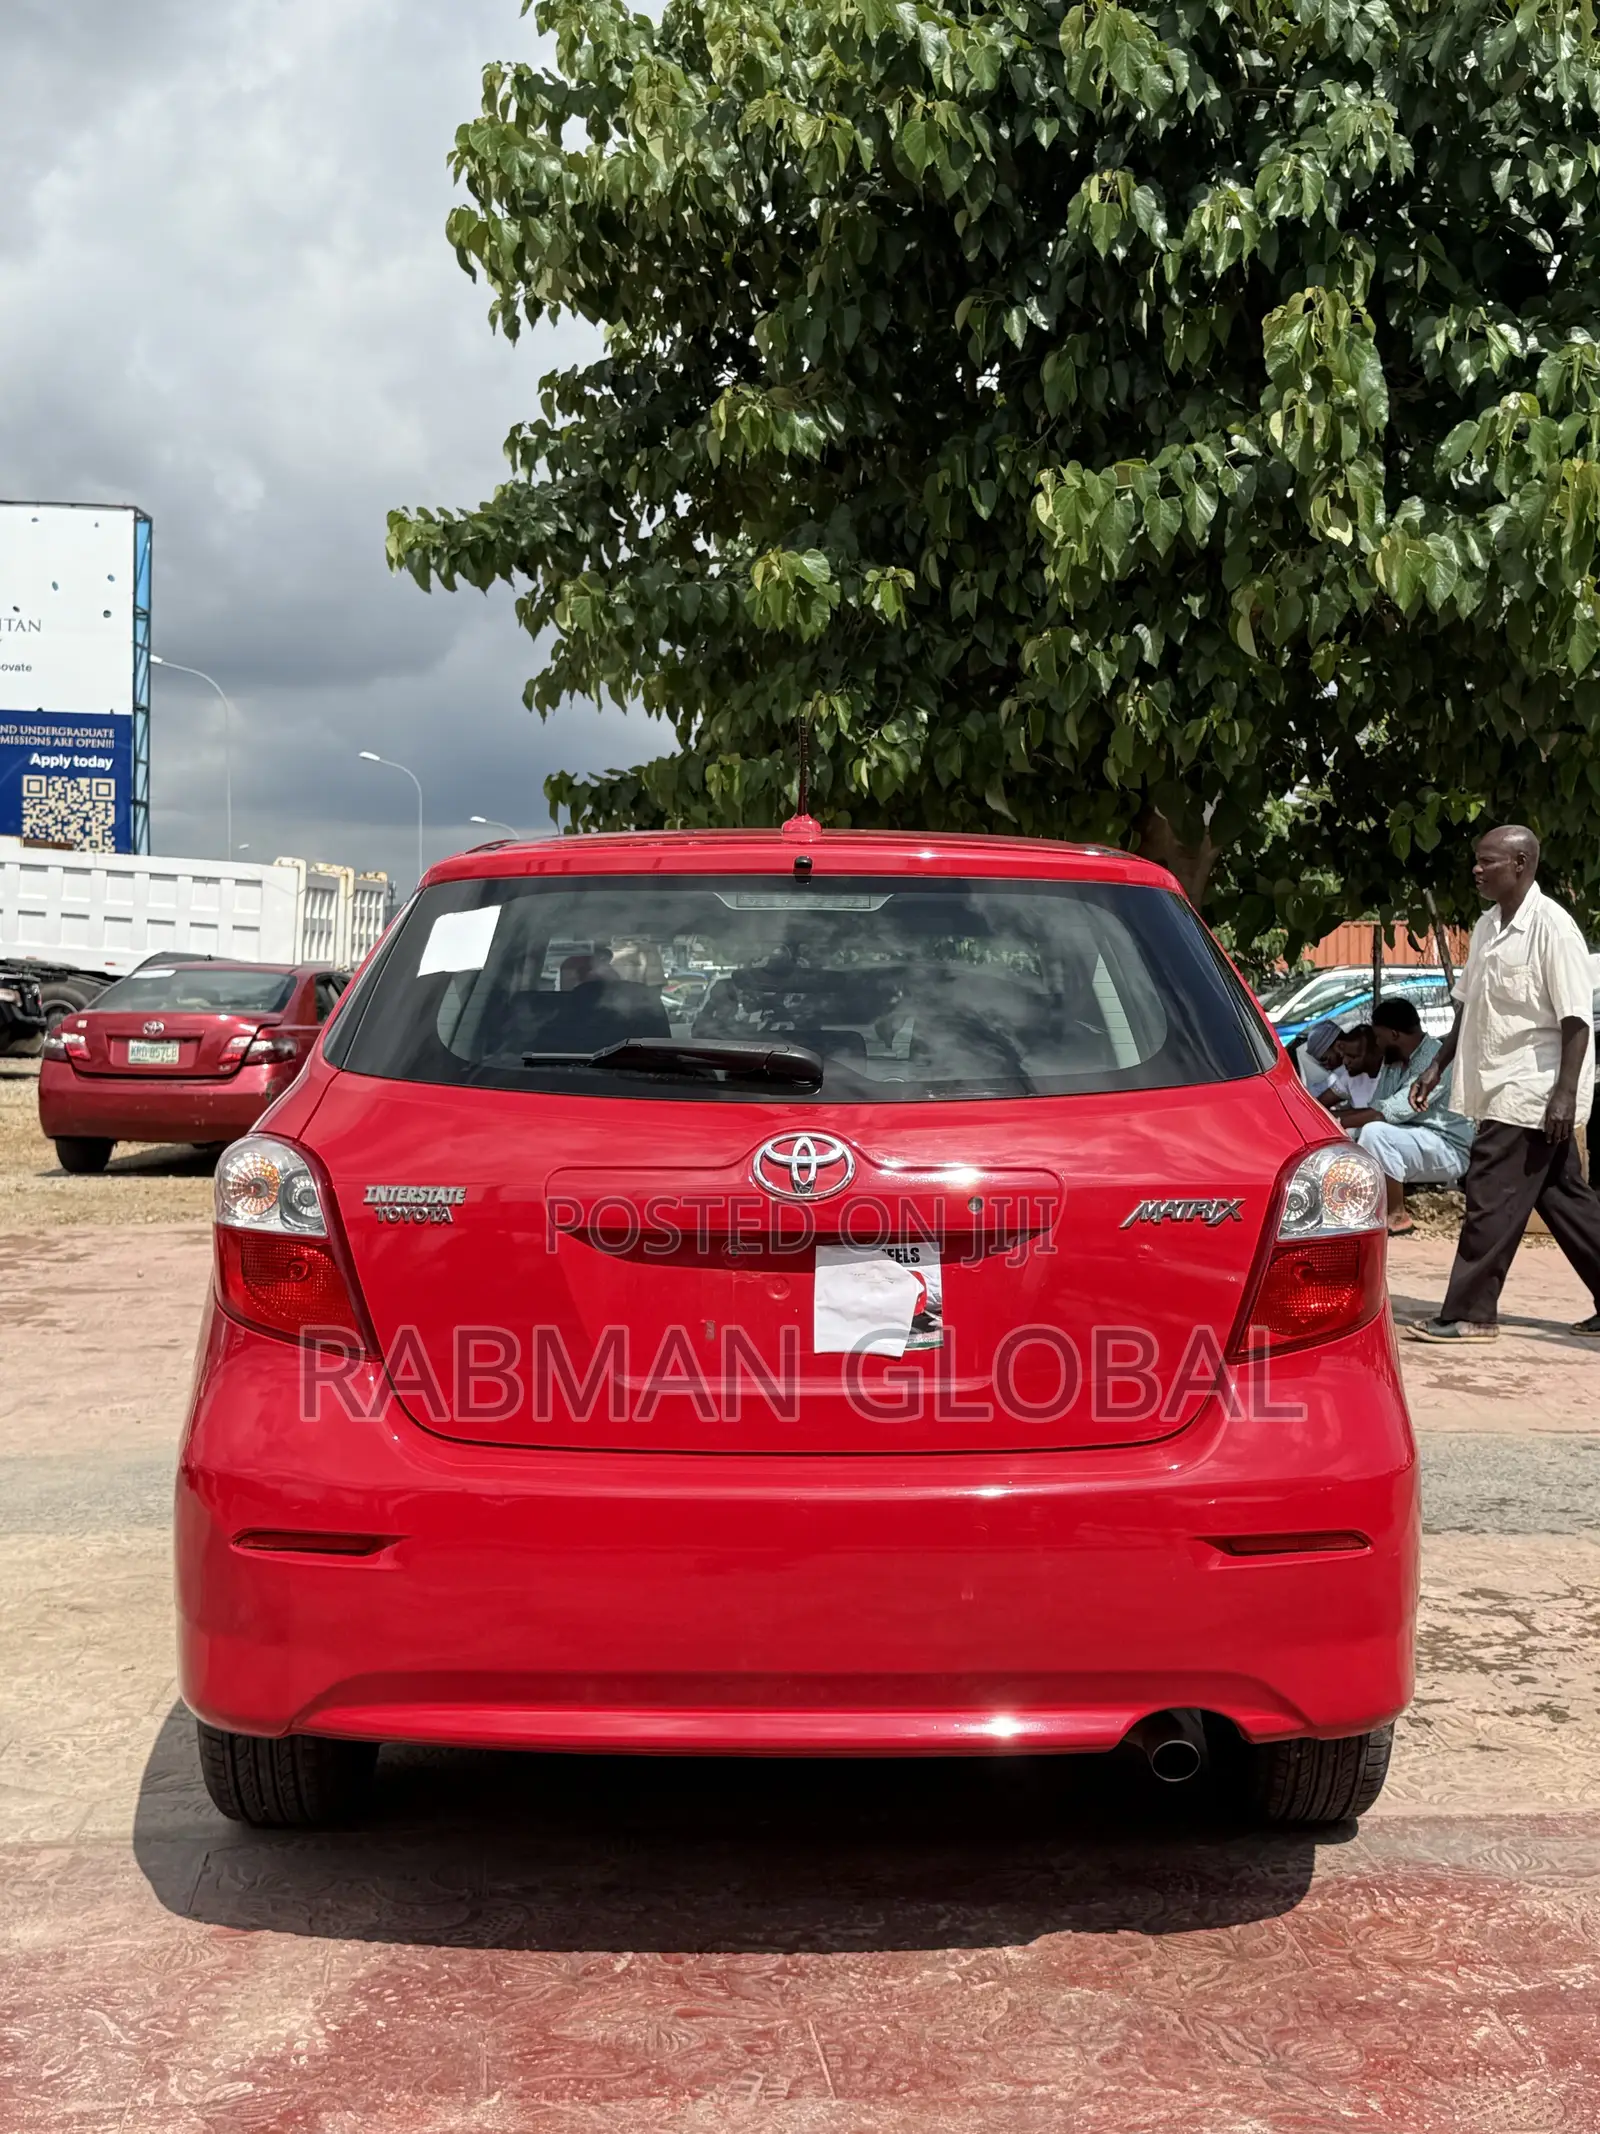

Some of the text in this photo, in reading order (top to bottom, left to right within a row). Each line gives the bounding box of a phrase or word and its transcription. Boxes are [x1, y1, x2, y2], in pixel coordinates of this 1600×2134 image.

[0, 662, 33, 672] ovate
[20, 725, 116, 739] UNDERGRADUATE
[53, 738, 74, 748] ARE
[30, 752, 114, 771] Apply today
[363, 1185, 467, 1205] INTERSTATE
[375, 1206, 453, 1223] TOYOTA
[1118, 1198, 1246, 1230] MATRIX
